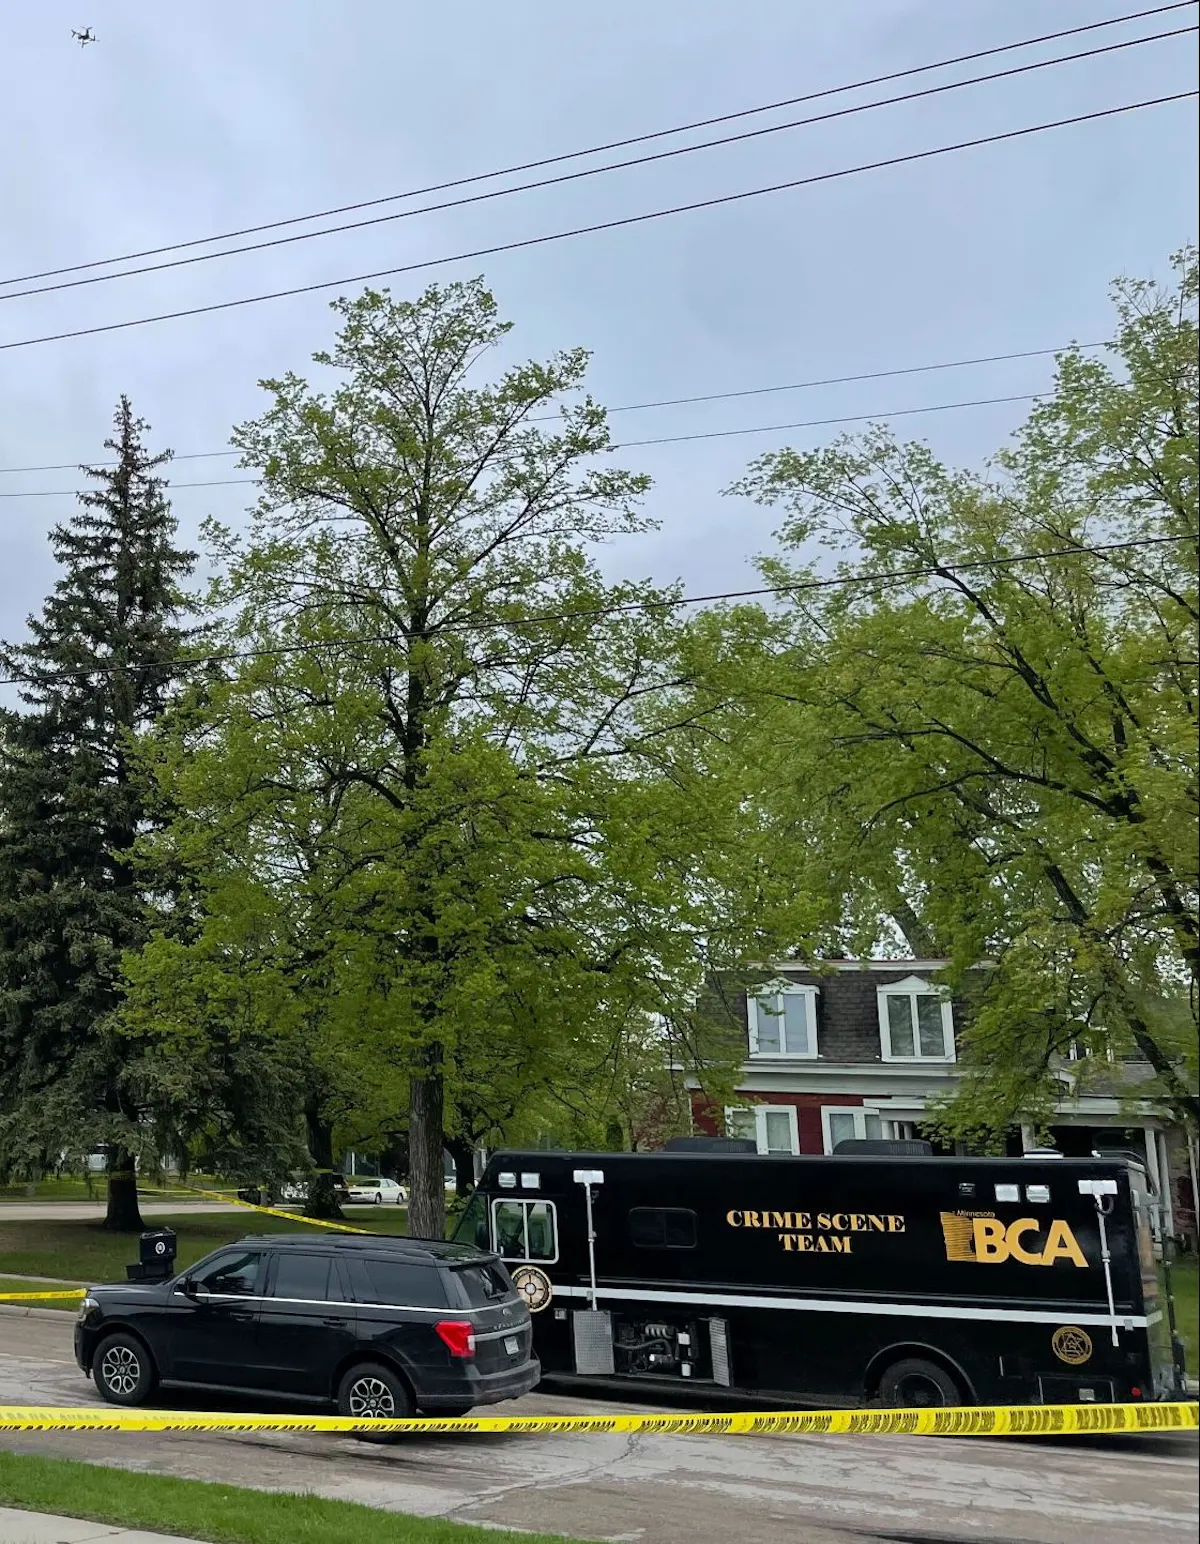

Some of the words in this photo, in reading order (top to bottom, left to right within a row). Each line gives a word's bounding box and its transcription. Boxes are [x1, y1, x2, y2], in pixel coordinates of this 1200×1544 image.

[726, 1209, 812, 1230] CRIME
[817, 1212, 906, 1233] SCENE
[956, 1209, 996, 1219] Minnesota
[778, 1233, 853, 1254] TEAM
[972, 1217, 1090, 1268] BCA
